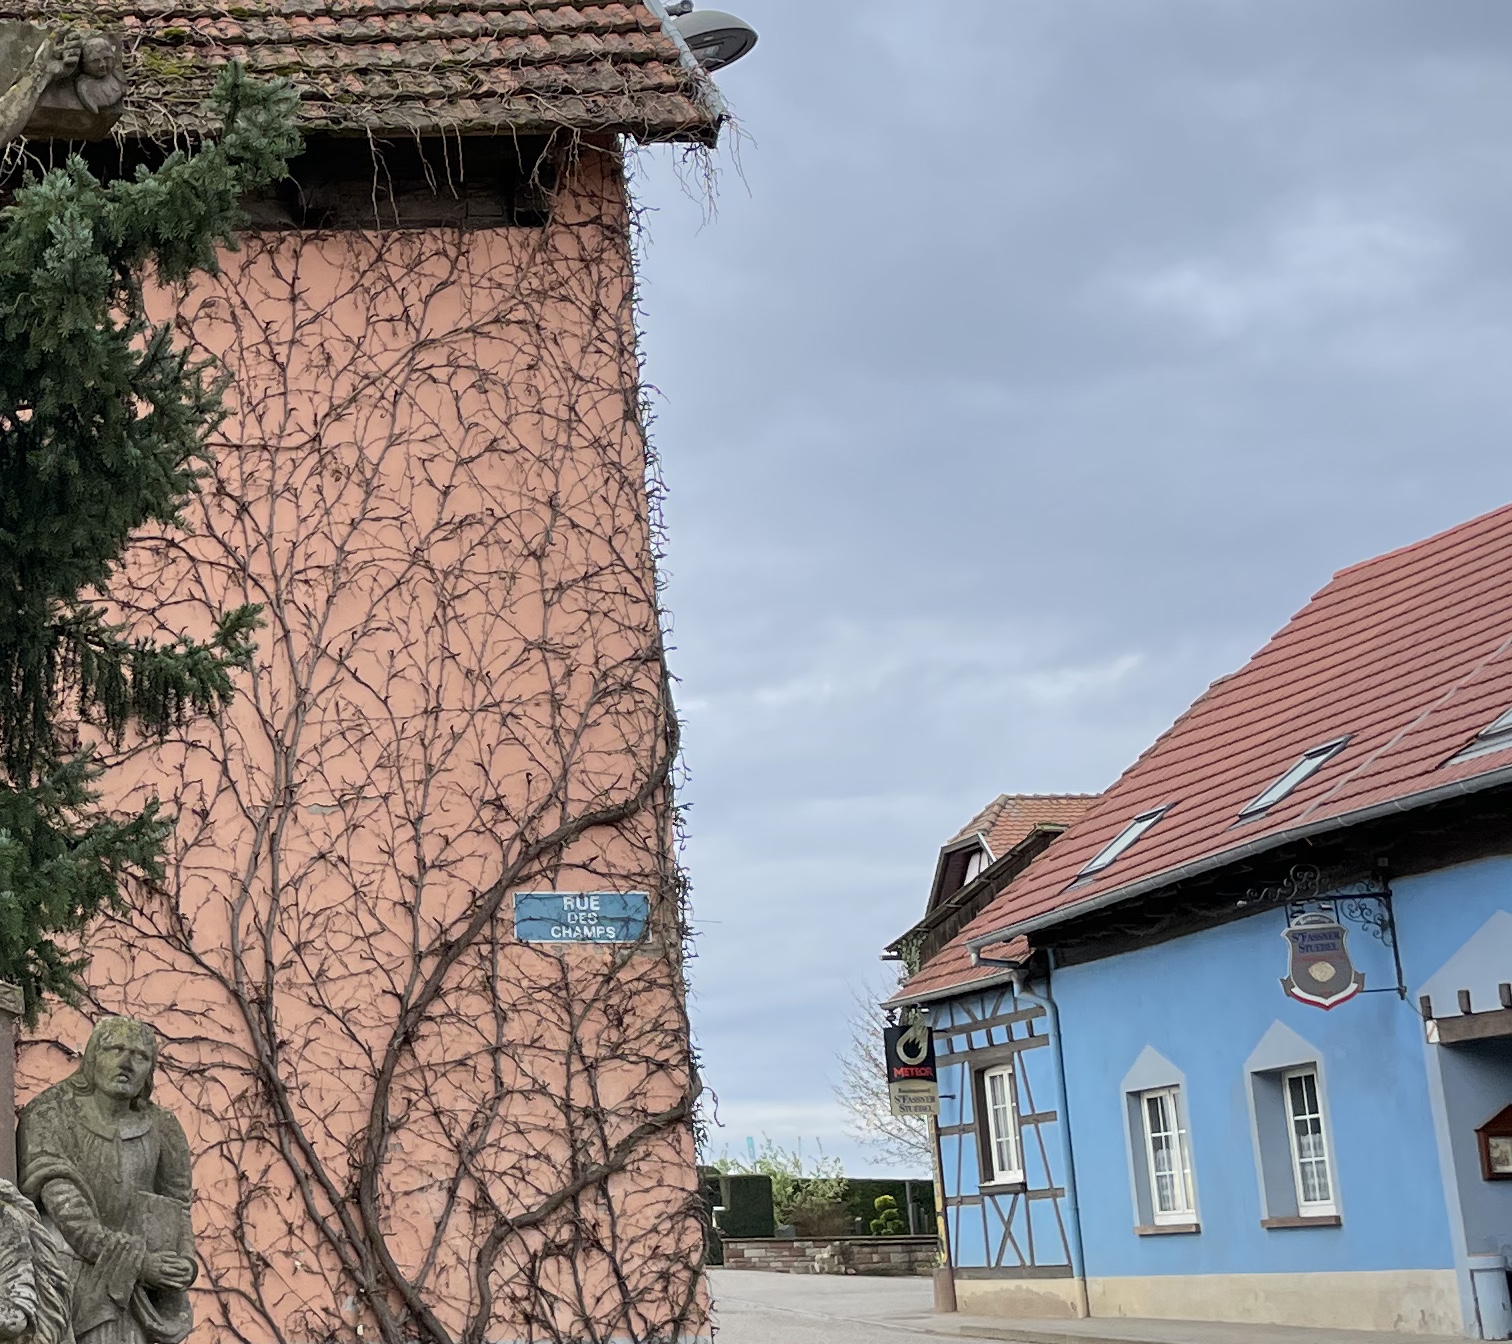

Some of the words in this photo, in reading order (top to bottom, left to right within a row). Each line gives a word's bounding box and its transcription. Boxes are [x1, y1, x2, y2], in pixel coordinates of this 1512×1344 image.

[563, 895, 600, 911] RUE
[567, 912, 598, 925] DES
[550, 925, 616, 939] CHAMPS
[892, 1067, 934, 1078] METEOR
